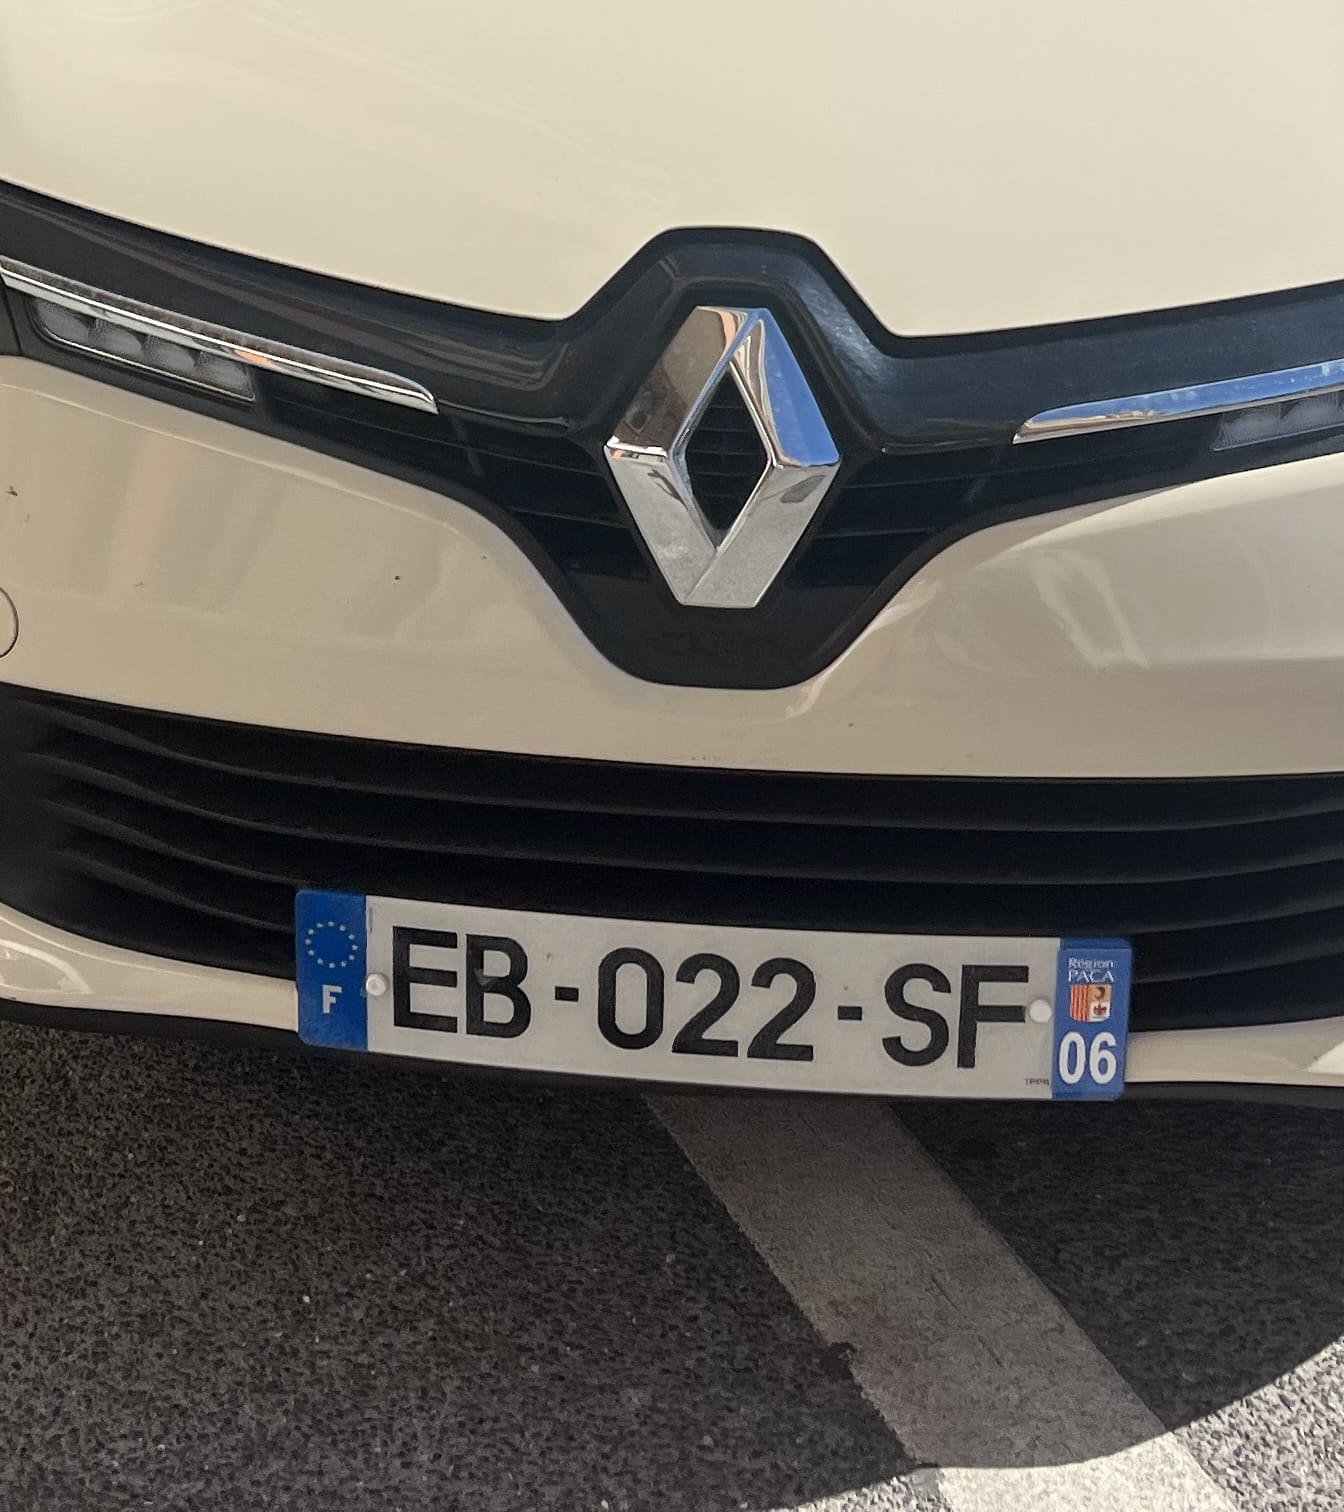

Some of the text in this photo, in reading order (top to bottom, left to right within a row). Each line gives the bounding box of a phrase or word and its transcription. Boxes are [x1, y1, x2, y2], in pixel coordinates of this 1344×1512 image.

[391, 925, 1030, 1069] EB-022-SF
[1067, 970, 1115, 983] PACA
[321, 984, 343, 1015] F
[1058, 1031, 1118, 1085] 06
